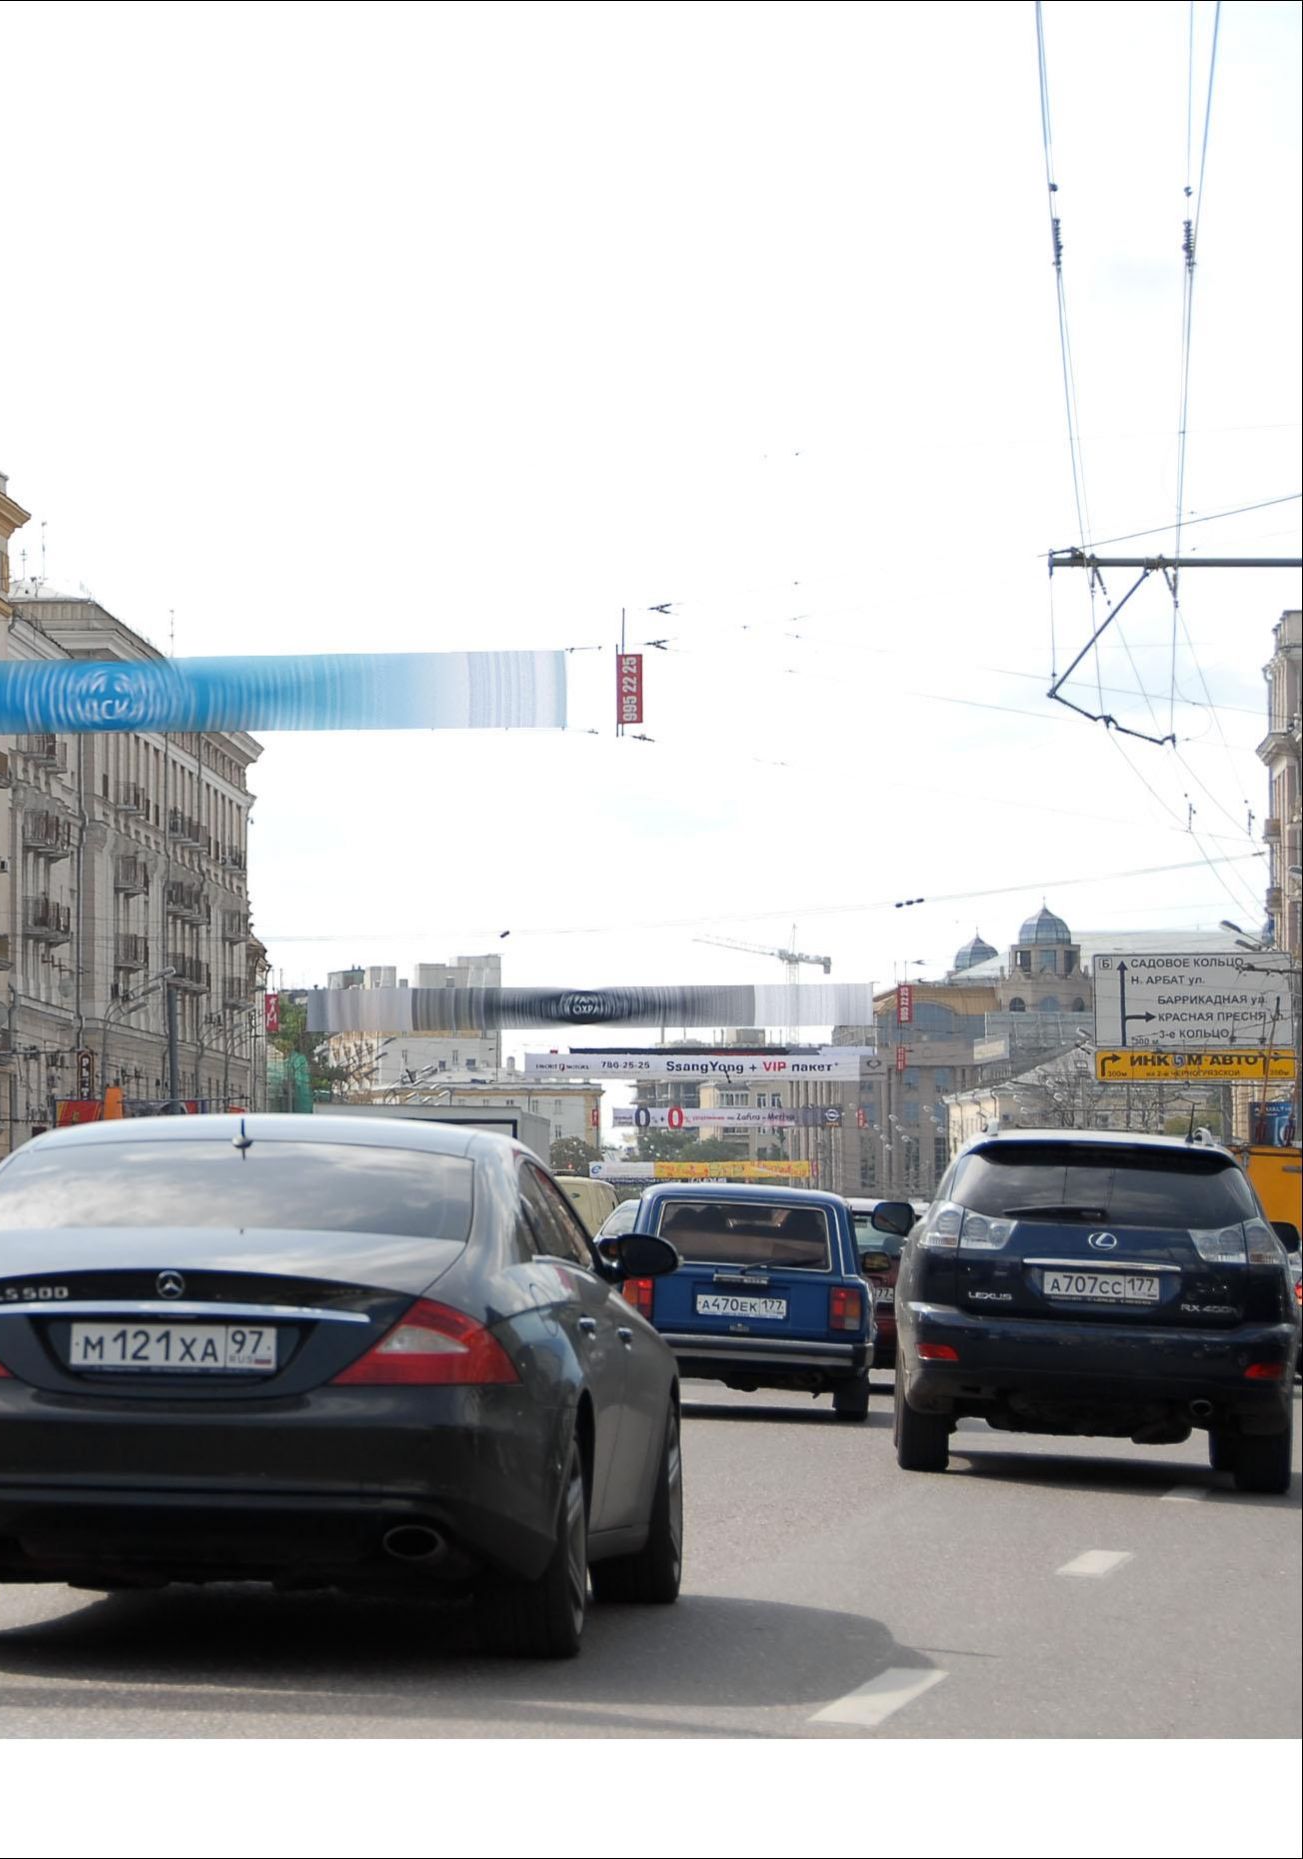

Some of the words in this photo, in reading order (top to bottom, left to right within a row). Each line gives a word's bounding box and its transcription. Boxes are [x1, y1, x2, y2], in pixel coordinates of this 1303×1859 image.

[622, 657, 637, 673] 25
[622, 676, 637, 693] 22
[622, 695, 637, 721] 995
[1101, 959, 1110, 969] Б
[1131, 958, 1190, 969] САДОВОЕ
[1193, 958, 1244, 969] КОЛЬЦО
[1131, 976, 1142, 985] Н.
[1146, 976, 1185, 985] АРБАТ
[1189, 977, 1205, 986] ул.
[1158, 995, 1247, 1005] БАРРИКАДНАЯ
[1158, 1012, 1213, 1022] КРАСНАЯ
[1218, 1012, 1266, 1021] ПРЕСНЯ
[1179, 1029, 1230, 1040] КОЛЬЦО
[1209, 1054, 1259, 1066] АВТО
[666, 1061, 744, 1073] SsangYong
[749, 1064, 757, 1072] +
[762, 1061, 787, 1071] VIP
[1050, 1276, 1123, 1295] А707СС
[1128, 1277, 1154, 1293] 177
[968, 1291, 1012, 1301] LEXUS
[702, 1298, 757, 1312] А470ЕК
[762, 1299, 783, 1310] 177
[1180, 1303, 1201, 1313] RX
[83, 1330, 219, 1362] М121ХА
[230, 1330, 263, 1354] 97
